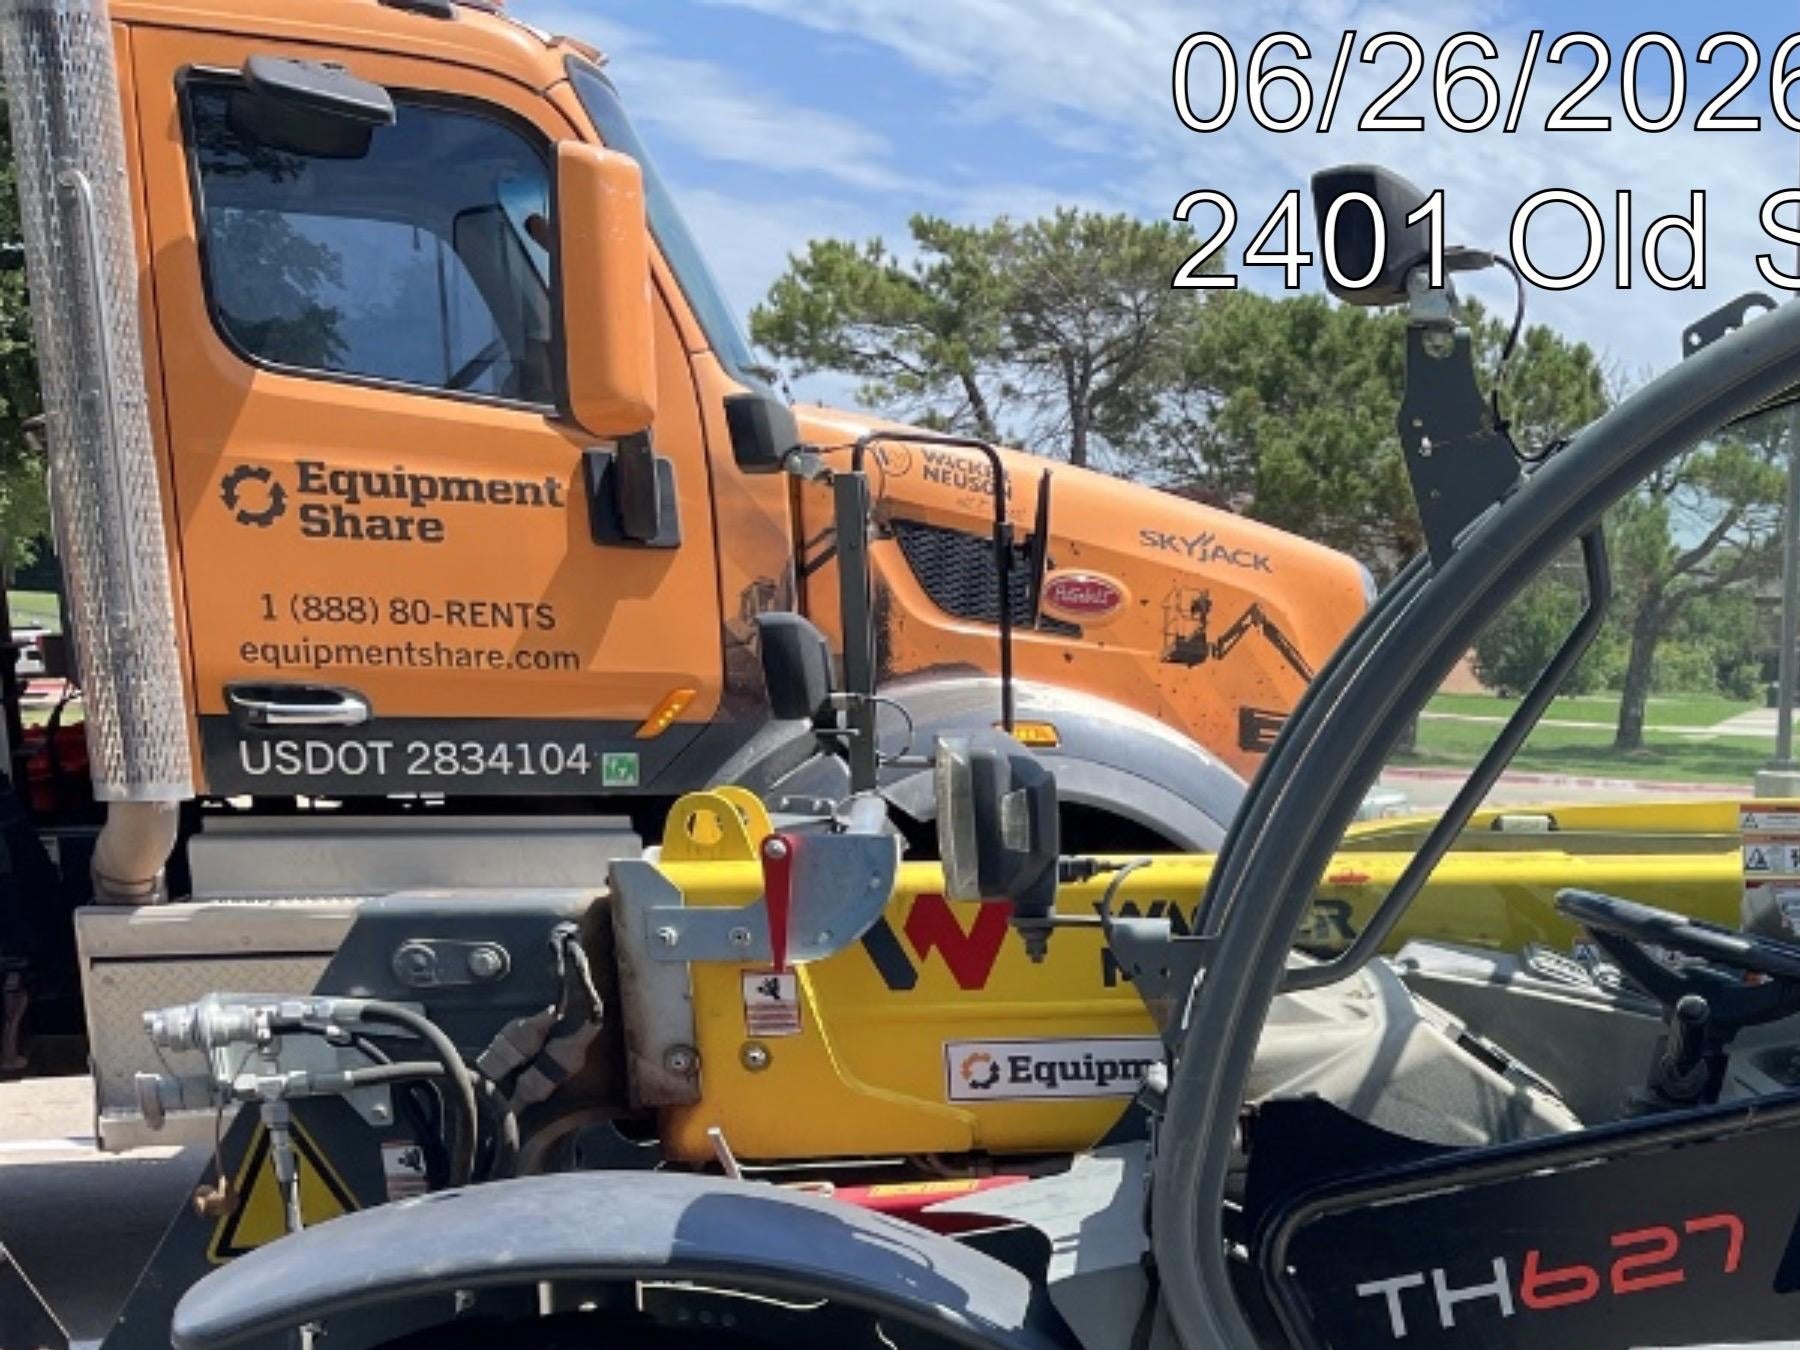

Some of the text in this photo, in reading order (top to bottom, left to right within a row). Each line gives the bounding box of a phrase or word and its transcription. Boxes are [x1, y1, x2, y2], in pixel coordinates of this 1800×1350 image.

[294, 459, 566, 508] Equipment
[299, 503, 445, 544] Share
[1139, 529, 1274, 573] SKYJACK
[260, 593, 557, 631] 1 (888) 80-RENTS
[239, 636, 581, 672] equipmentshare.com
[238, 739, 593, 777] USDOT 2834104
[1008, 1053, 1149, 1088] Equipm
[1355, 1213, 1745, 1340] TH627
